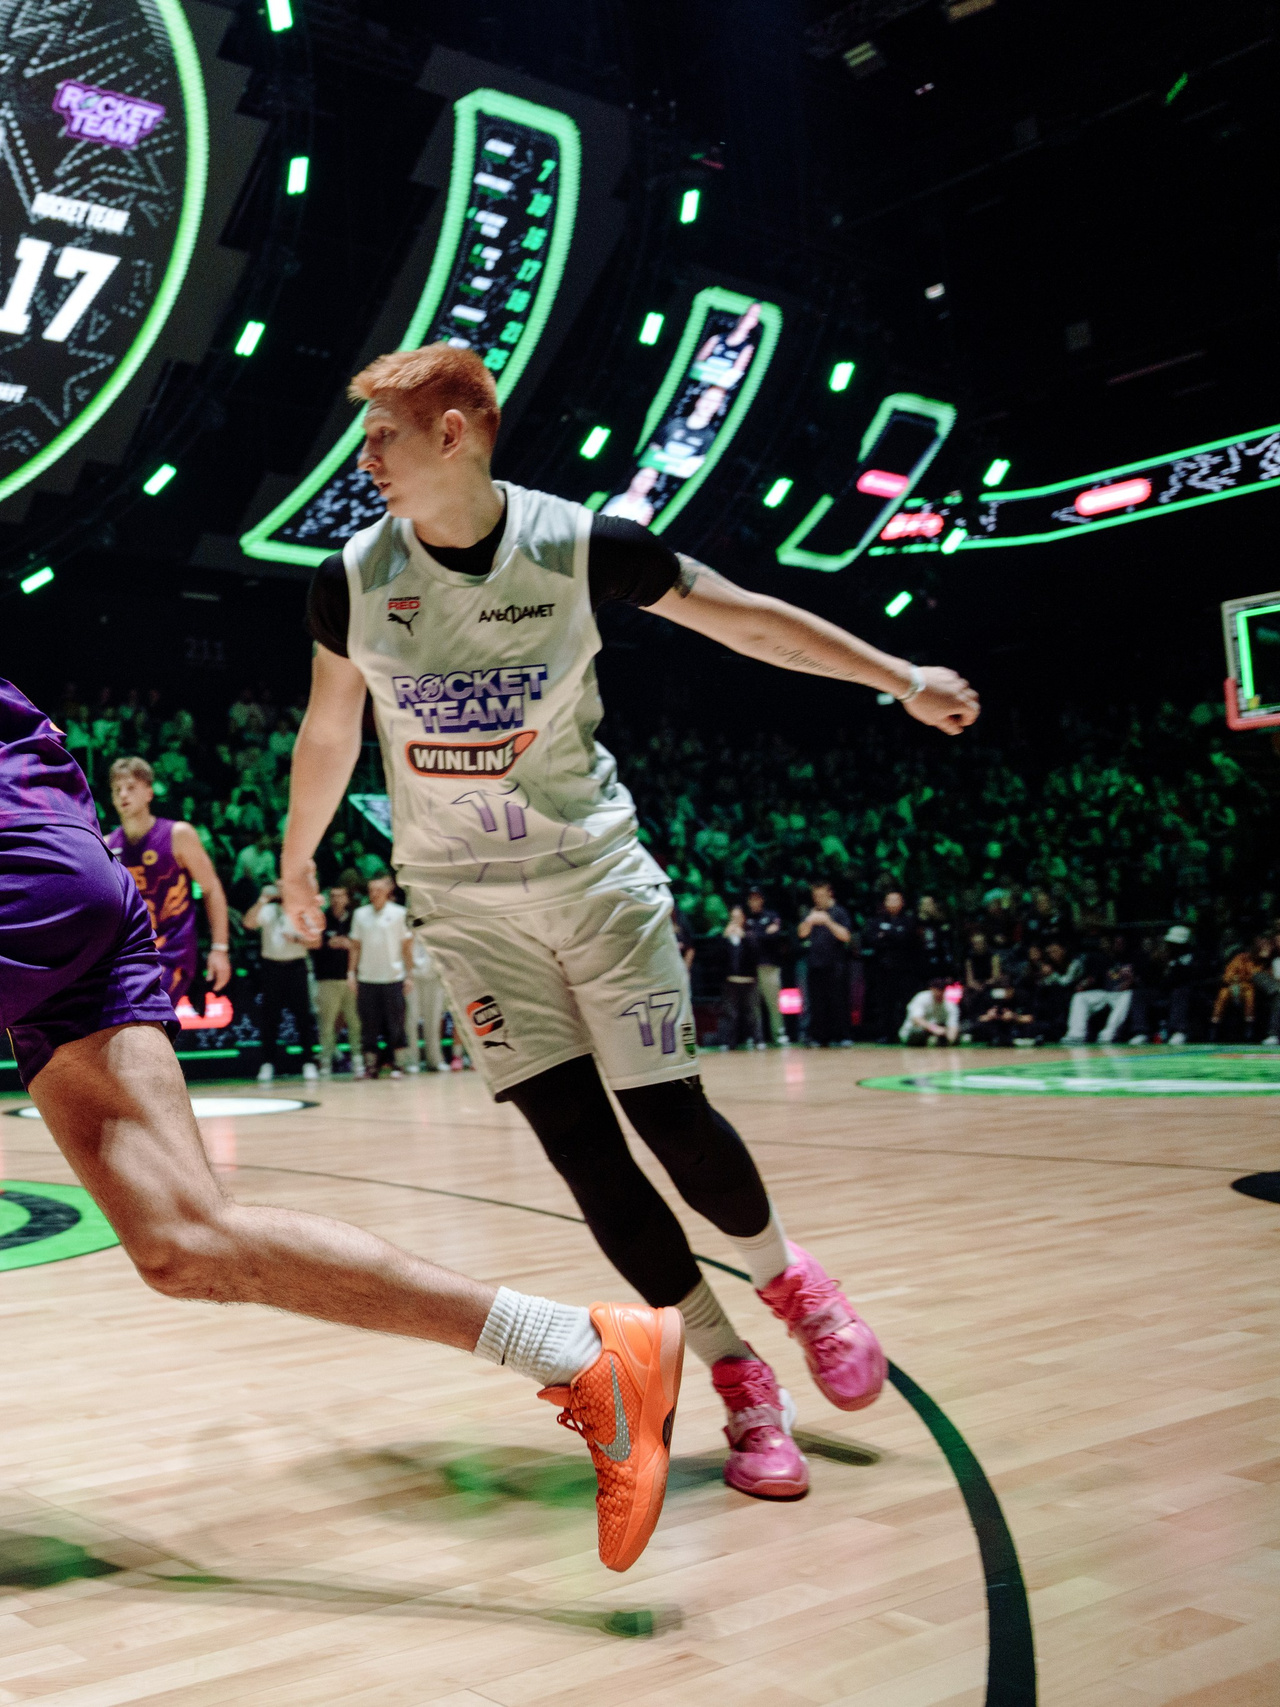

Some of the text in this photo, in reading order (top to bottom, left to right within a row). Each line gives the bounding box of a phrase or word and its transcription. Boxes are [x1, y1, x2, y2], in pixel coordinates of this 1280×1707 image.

[60, 85, 163, 129] ROCKET
[71, 112, 140, 145] TEAM
[387, 600, 421, 611] RED
[392, 663, 549, 710] ROCKET
[414, 696, 525, 734] TEAM
[412, 743, 515, 772] WINLINE
[618, 989, 680, 1055] 17
